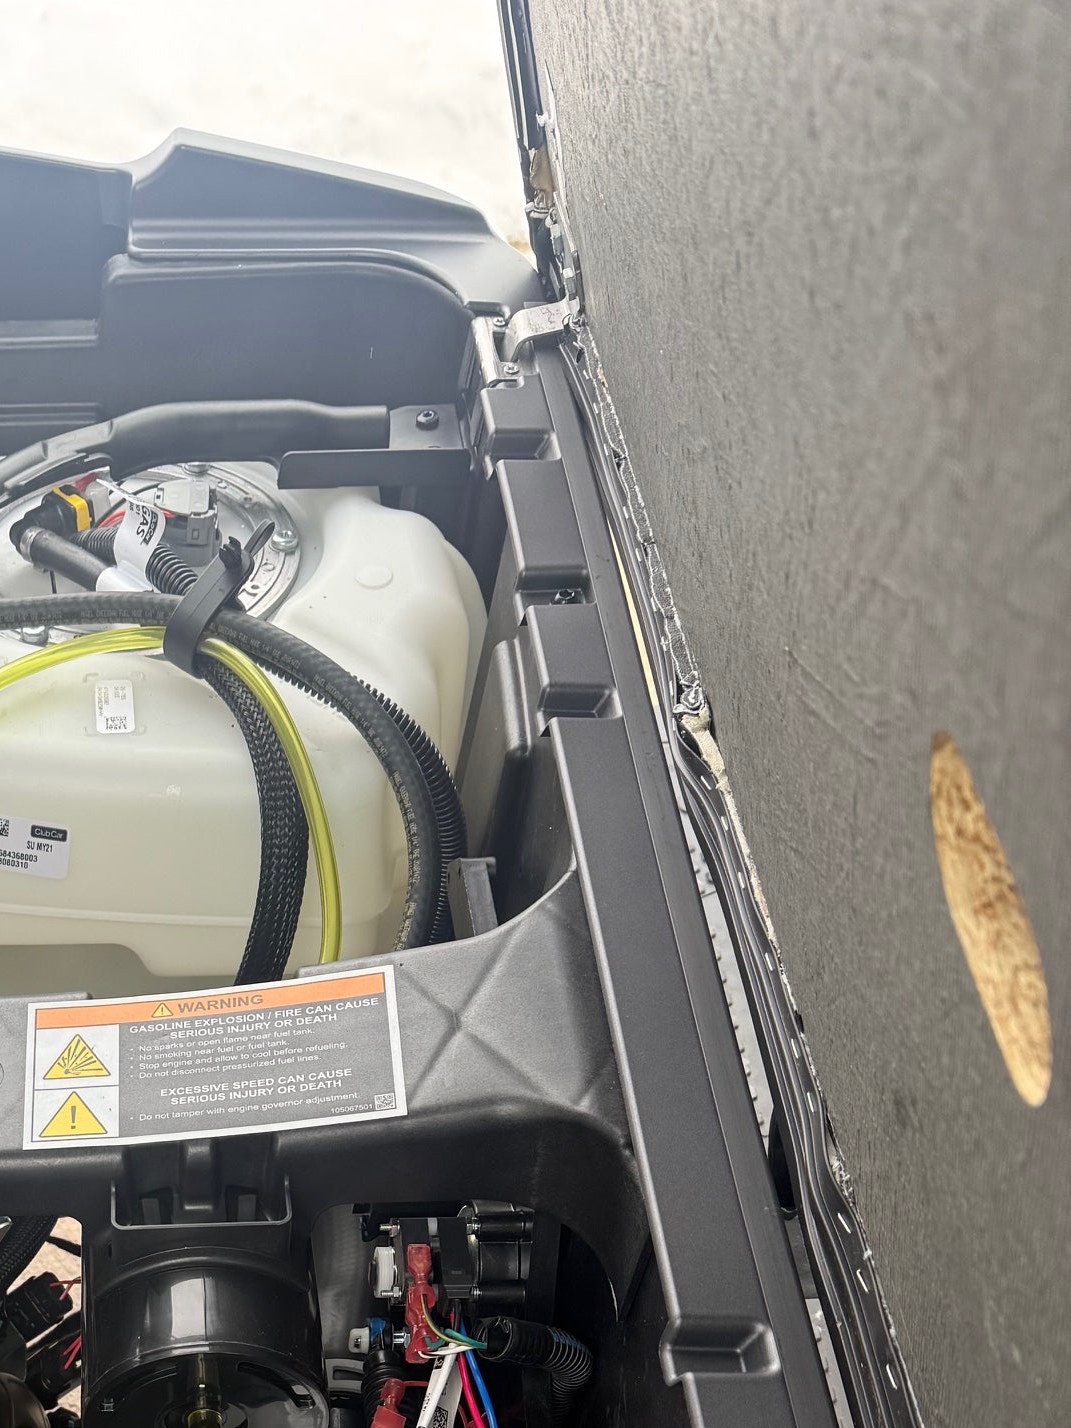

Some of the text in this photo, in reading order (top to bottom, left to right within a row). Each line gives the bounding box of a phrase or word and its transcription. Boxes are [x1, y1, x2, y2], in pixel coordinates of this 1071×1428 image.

[136, 505, 150, 537] GAS
[26, 840, 53, 853] SU MY21
[129, 997, 379, 1034] GASOLINE EXPLOSION / FIRE CAN CAUSE
[177, 994, 263, 1013] WARNING
[170, 1013, 337, 1039] SERIOUS INJURY OR DEATH
[139, 1053, 152, 1061] No
[154, 1049, 192, 1061] smoking
[217, 1045, 233, 1053] fuel
[248, 1041, 264, 1049] fuel
[267, 1038, 289, 1047] tank.
[139, 1040, 349, 1071] Stop engine and allow to cool before refueling.
[139, 1053, 322, 1079] Do not disconnect pressurized fuel lines.
[160, 1068, 352, 1097] EXCESSIVE SPEED CAN CAUSE
[170, 1079, 341, 1105] SERIOUS INJURY OR DEATH
